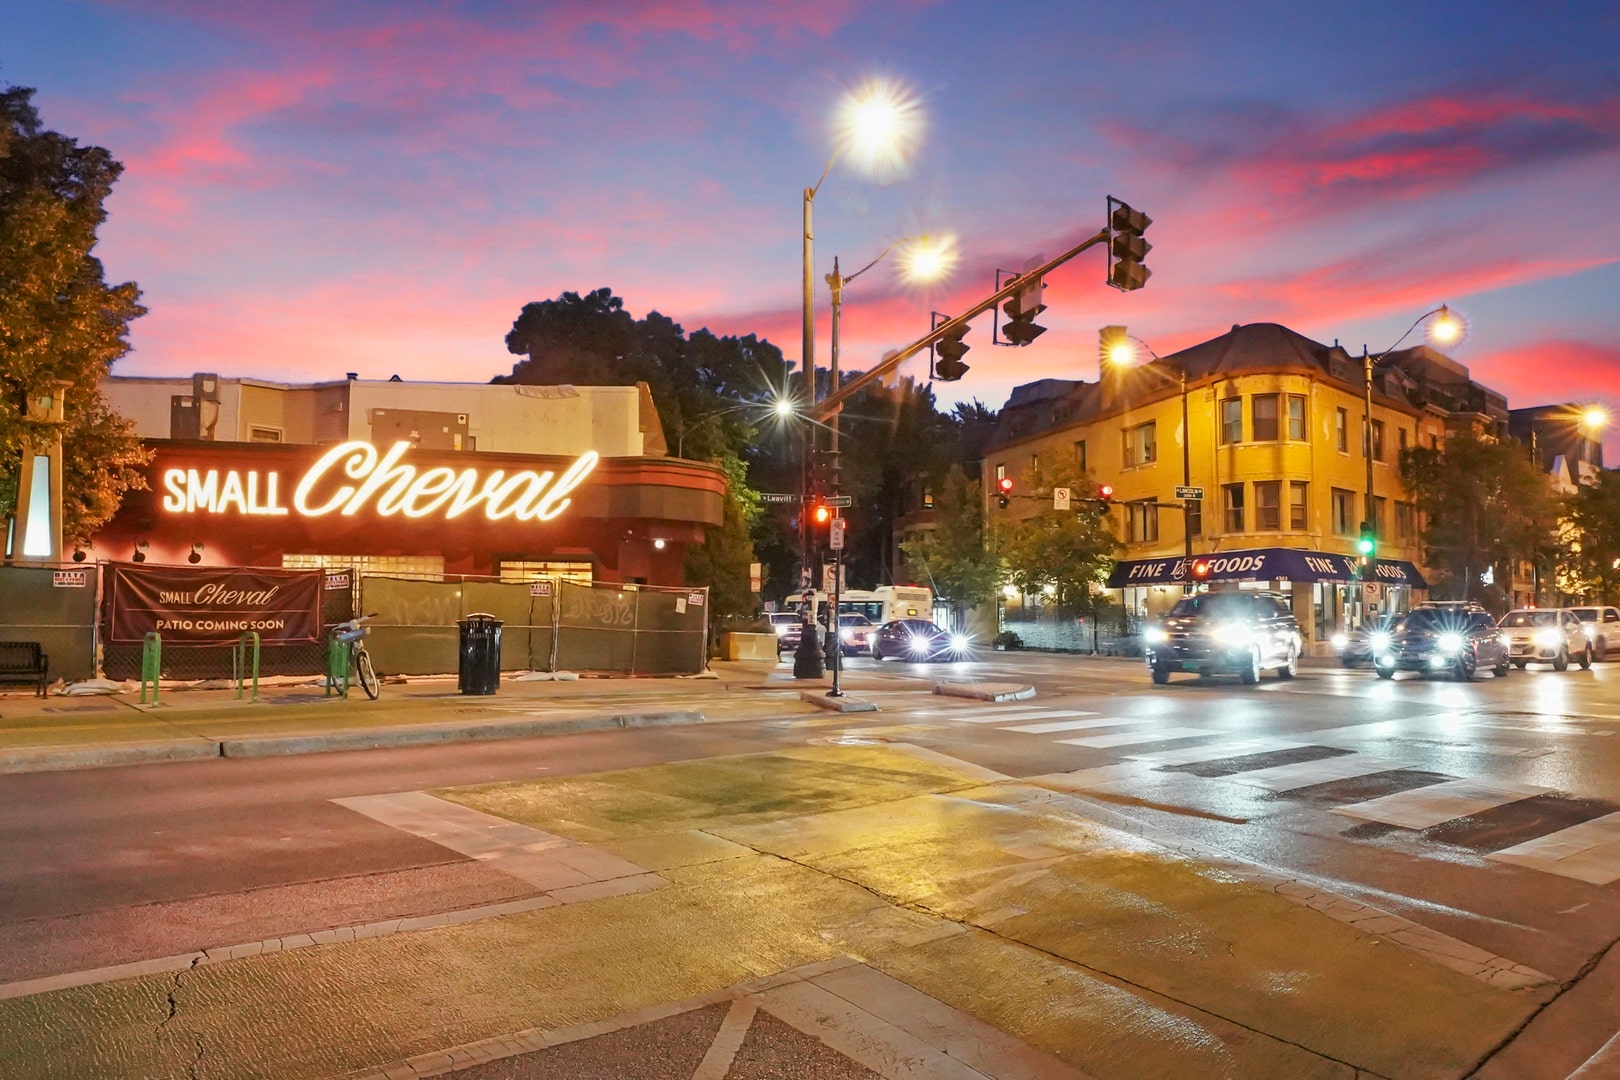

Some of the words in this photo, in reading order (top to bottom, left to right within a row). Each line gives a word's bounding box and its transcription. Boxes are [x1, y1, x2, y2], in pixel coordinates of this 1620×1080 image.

[164, 469, 288, 515] SMALL
[294, 441, 599, 521] Cheval
[1129, 563, 1166, 578] FINE
[1206, 555, 1266, 574] FOODS
[1304, 556, 1337, 574] FINE
[159, 592, 191, 604] SMALL
[194, 583, 279, 605] Cheval
[156, 620, 193, 630] PATIO
[195, 620, 248, 630] COMING
[250, 620, 284, 630] SOON
